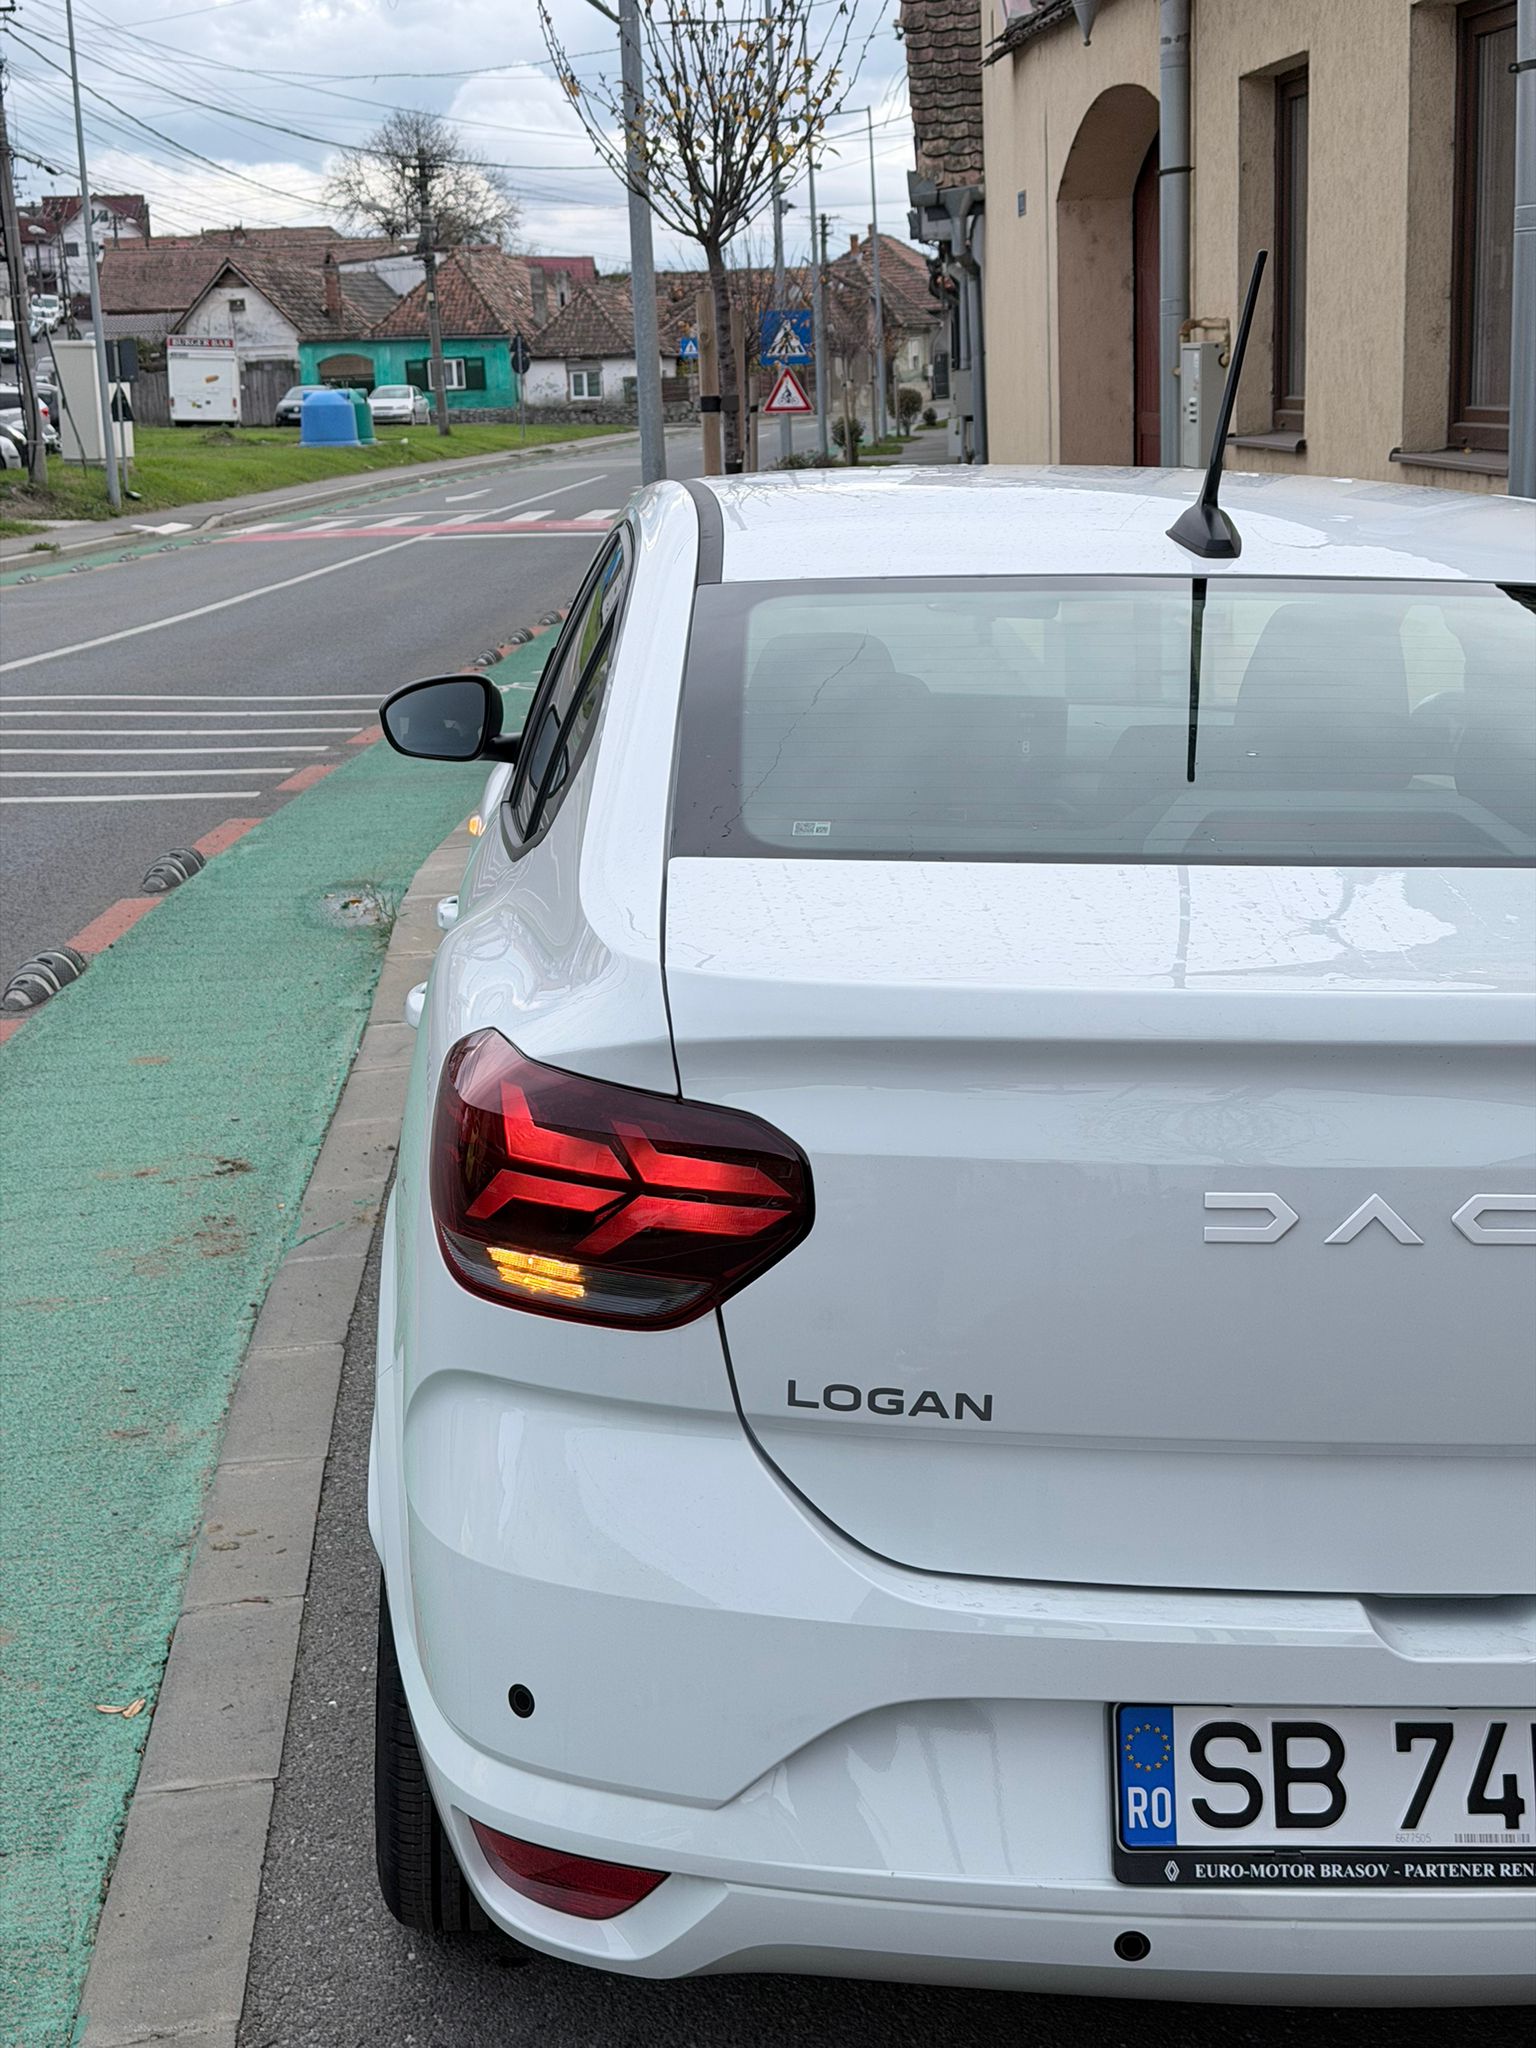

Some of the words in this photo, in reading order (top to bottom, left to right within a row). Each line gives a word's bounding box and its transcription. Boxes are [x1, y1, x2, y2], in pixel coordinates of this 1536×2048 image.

[1203, 1192, 1536, 1246] DAC
[787, 1379, 994, 1422] LOGAN
[1190, 1721, 1347, 1829] SB
[1395, 1722, 1536, 1829] 74
[1127, 1786, 1171, 1829] RO
[1195, 1863, 1316, 1878] EURO-MOTOR
[1320, 1863, 1389, 1878] BRASOV
[1404, 1863, 1496, 1878] PARTENER
[1499, 1863, 1536, 1878] REN
